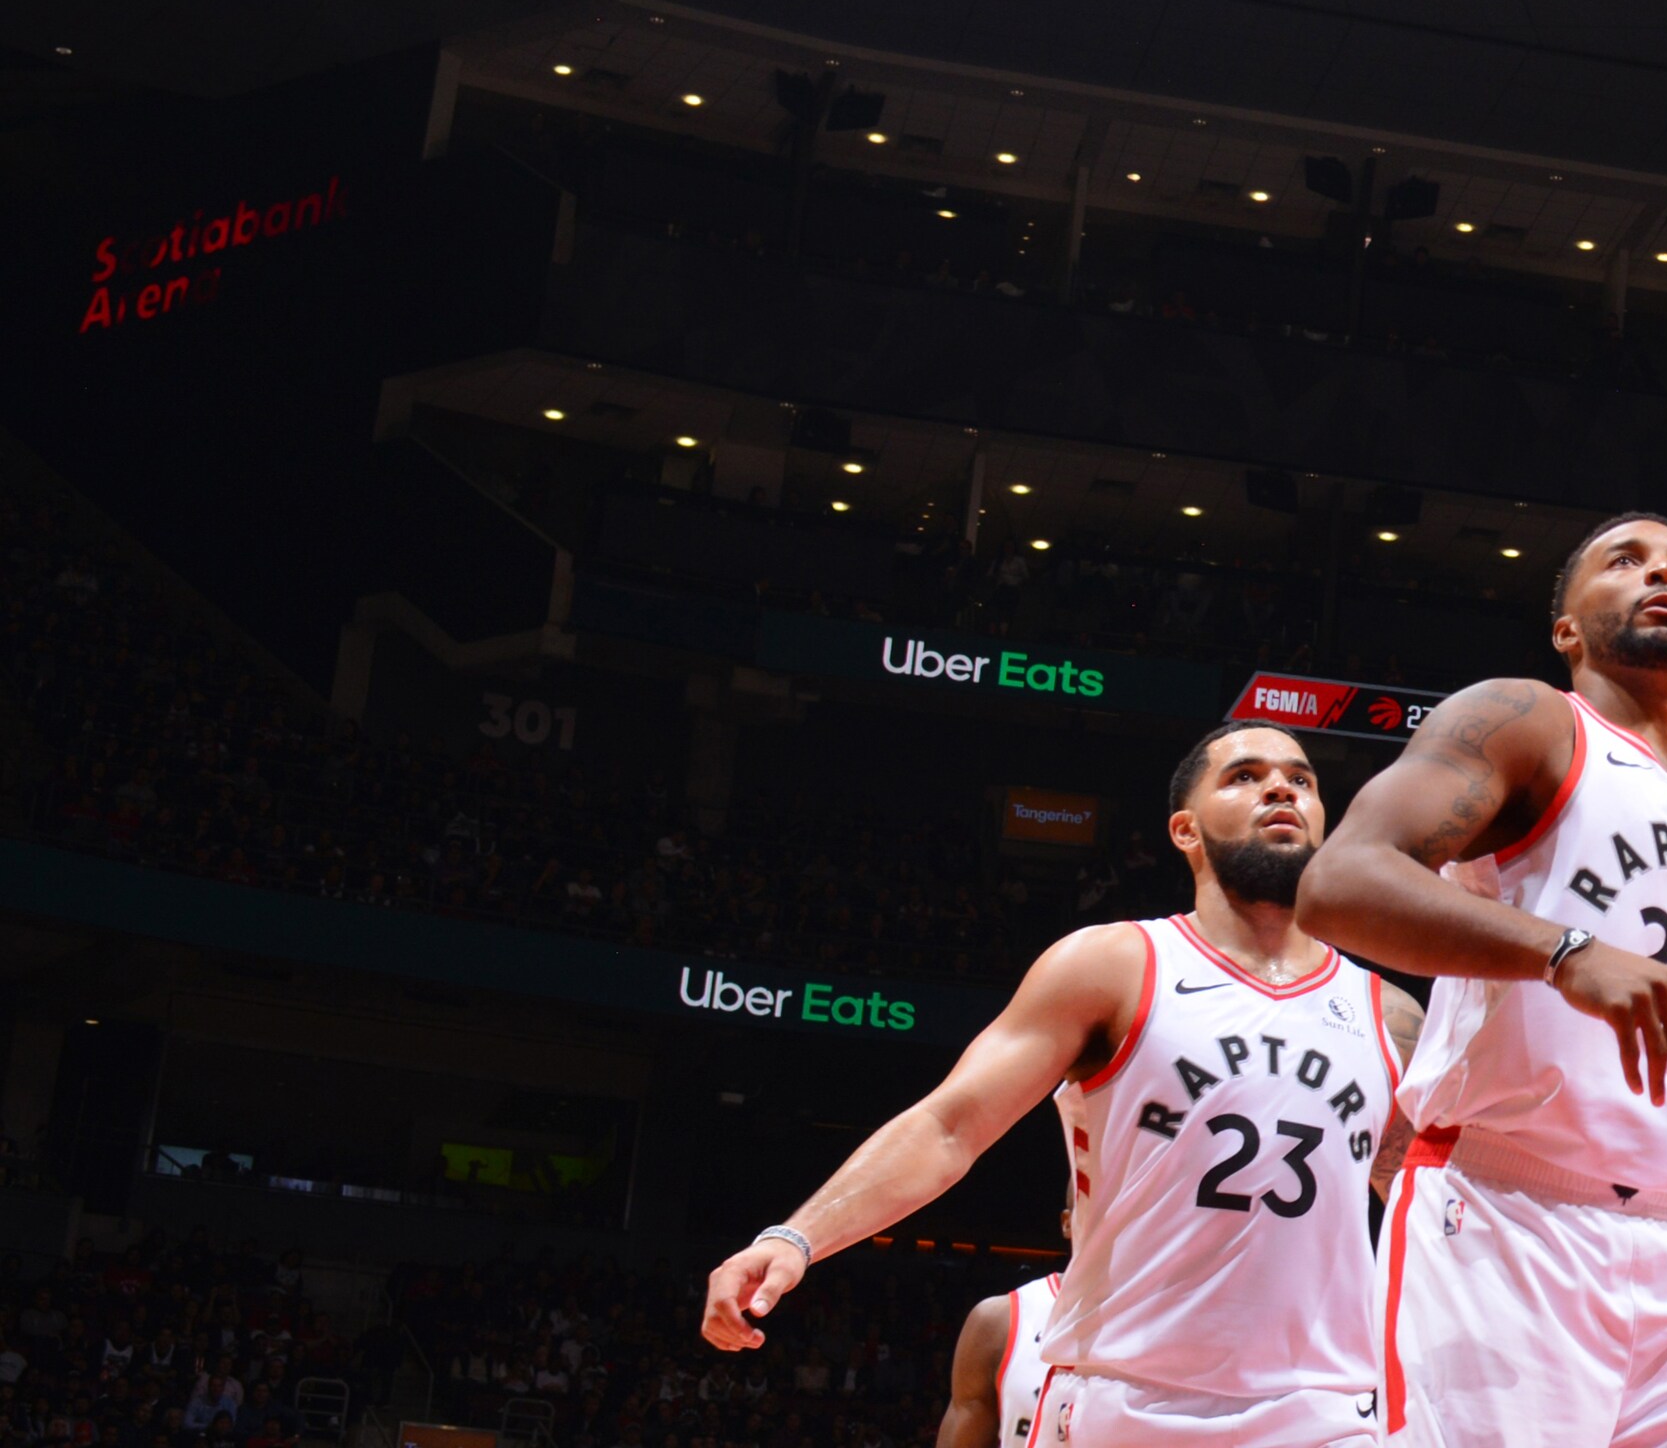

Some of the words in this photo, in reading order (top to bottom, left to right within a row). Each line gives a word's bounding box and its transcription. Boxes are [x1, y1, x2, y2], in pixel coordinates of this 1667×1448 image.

[882, 637, 989, 683] Uber
[998, 652, 1104, 697] Eats
[479, 692, 576, 751] 301
[1255, 687, 1317, 715] FGM/A
[1012, 804, 1083, 824] Tangerine
[679, 966, 793, 1018] Uber
[801, 983, 915, 1031] Eats
[1137, 1033, 1374, 1166] RAPTORS
[1195, 1113, 1325, 1219] 23
